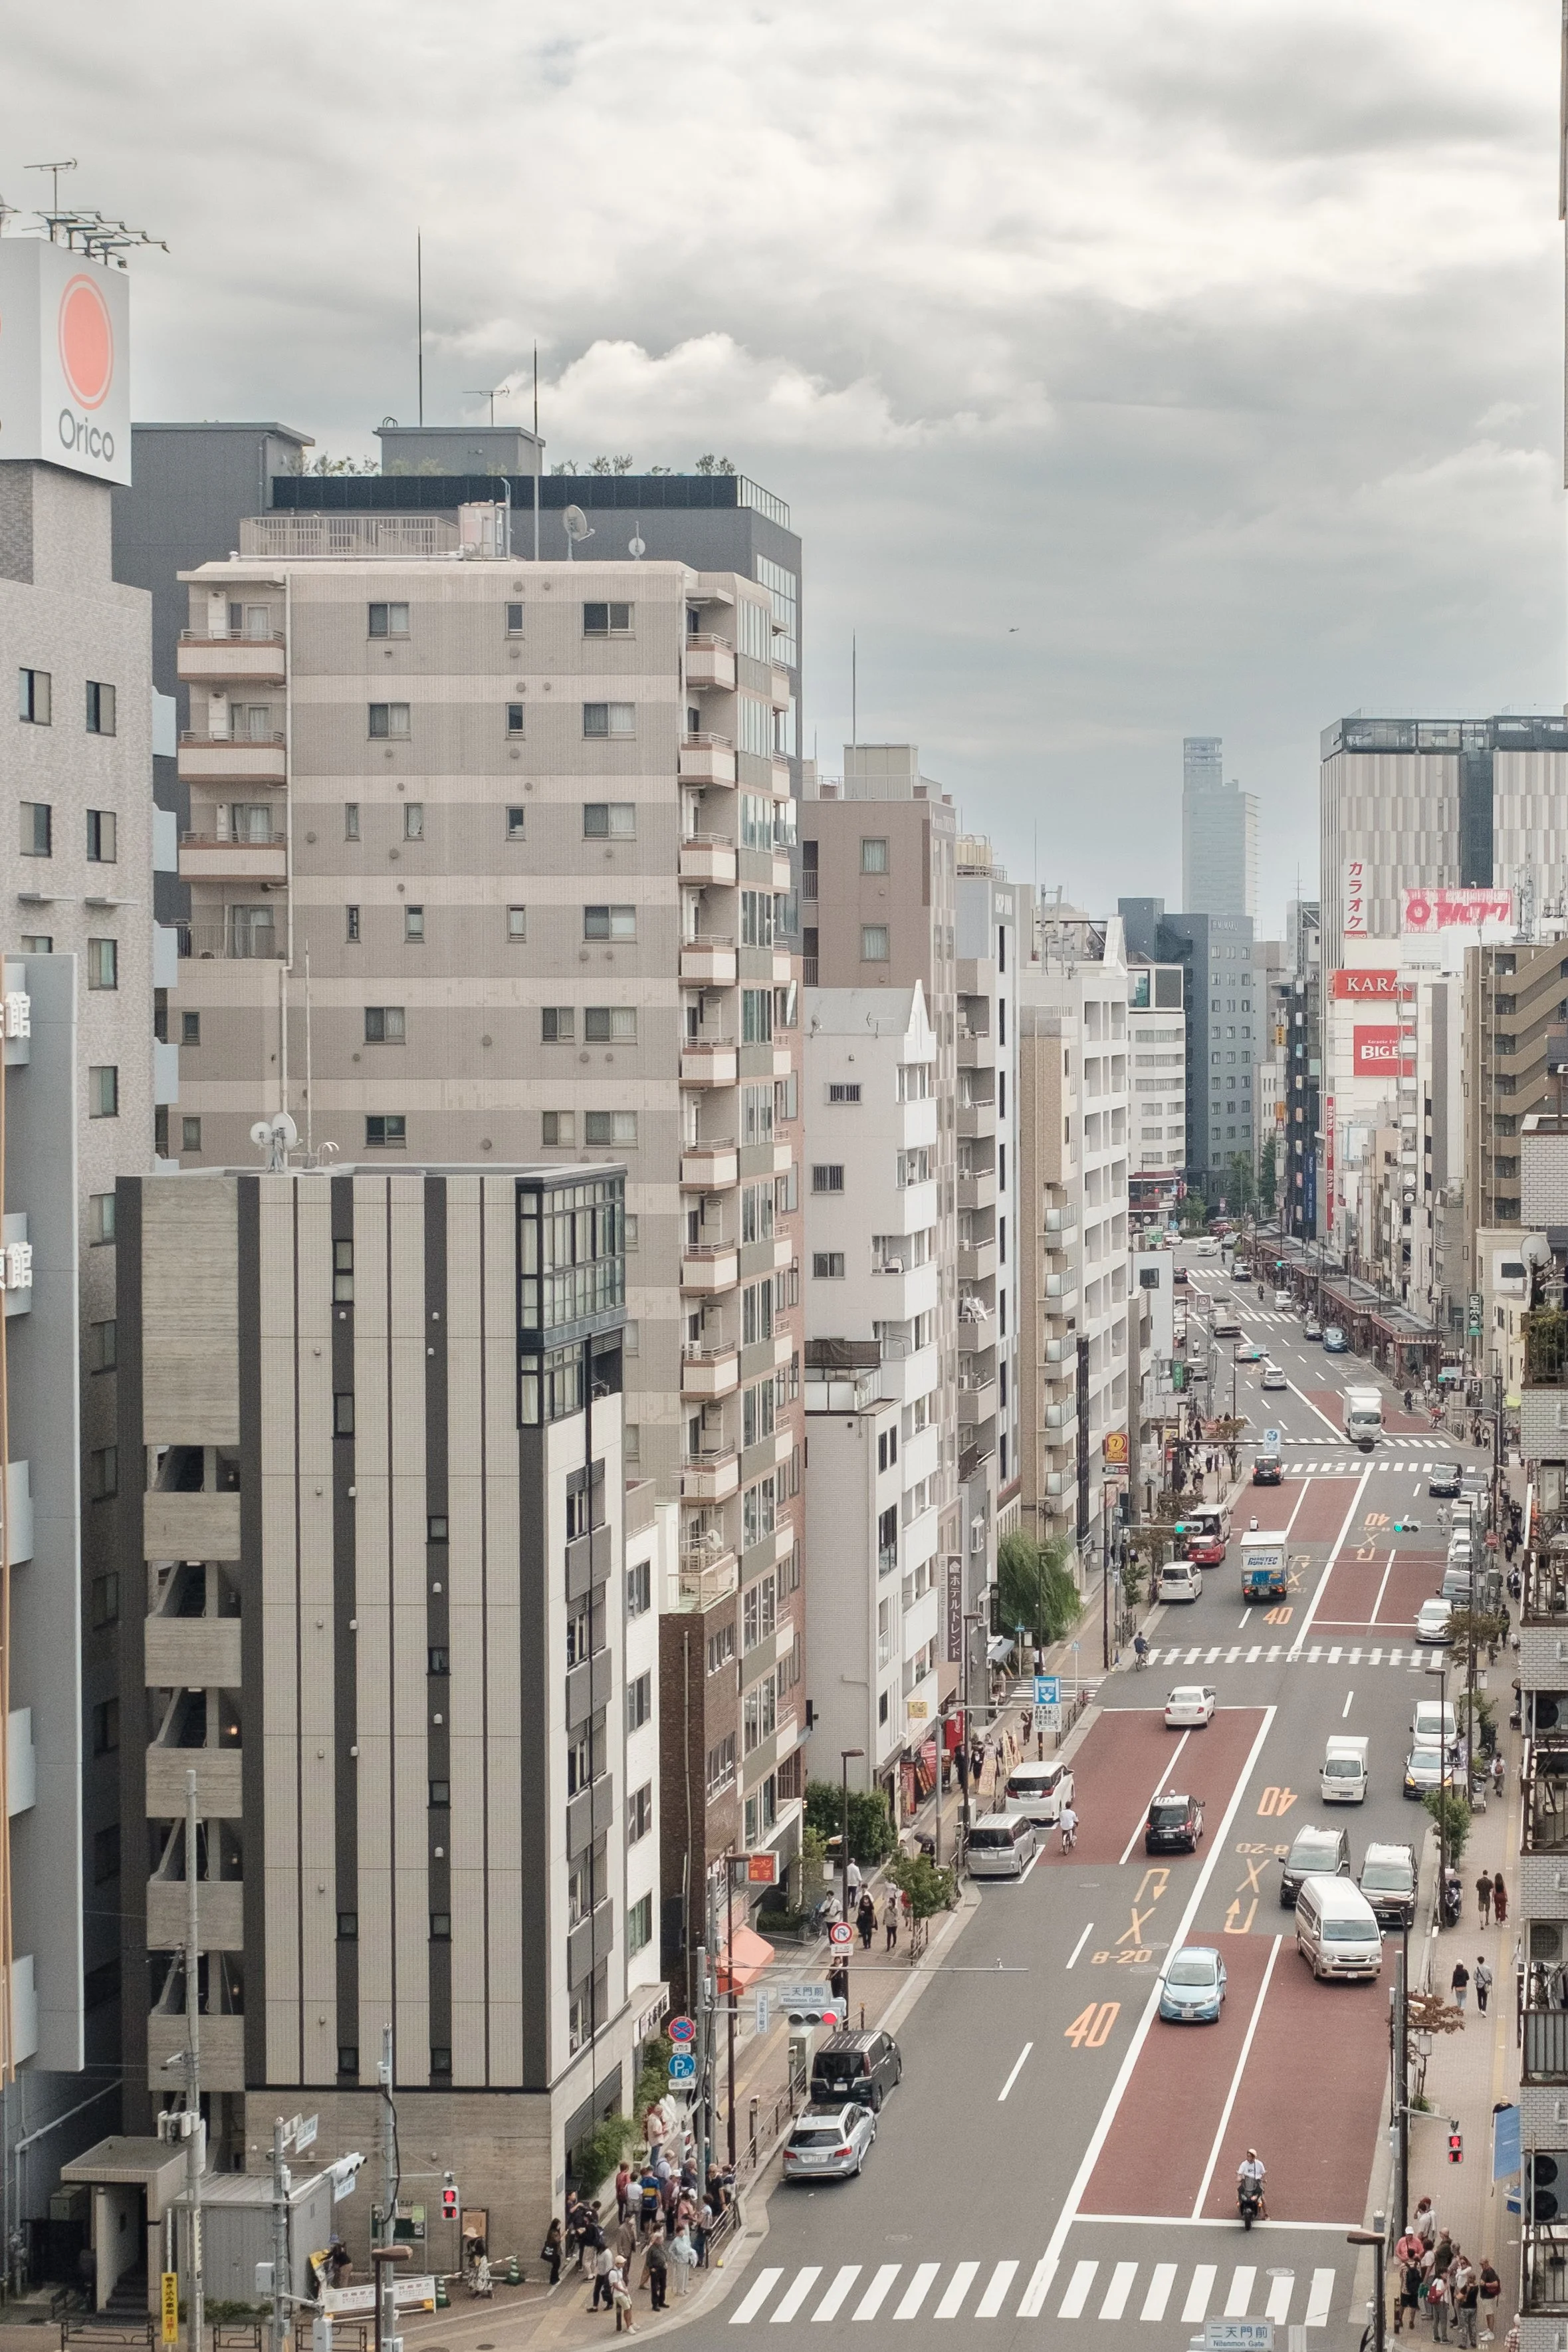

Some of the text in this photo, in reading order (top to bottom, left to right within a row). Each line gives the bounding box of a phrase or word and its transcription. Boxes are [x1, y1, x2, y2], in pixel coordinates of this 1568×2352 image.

[59, 408, 114, 463] Orico
[1348, 862, 1363, 929] カラオケ
[1361, 1045, 1390, 1060] BIG
[1469, 1296, 1480, 1315] CAFE
[1365, 1513, 1391, 1526] 40
[950, 1575, 961, 1659] ホテルトレンド
[1263, 1607, 1293, 1625] 40
[1256, 1787, 1298, 1816] 40
[1236, 1843, 1289, 1855] 8-20
[1091, 1949, 1153, 1964] 8-20
[780, 1986, 824, 1996] 二天門前
[1064, 2002, 1121, 2048] 40
[674, 2059, 685, 2077] P
[1210, 2325, 1268, 2339] 二天門前
